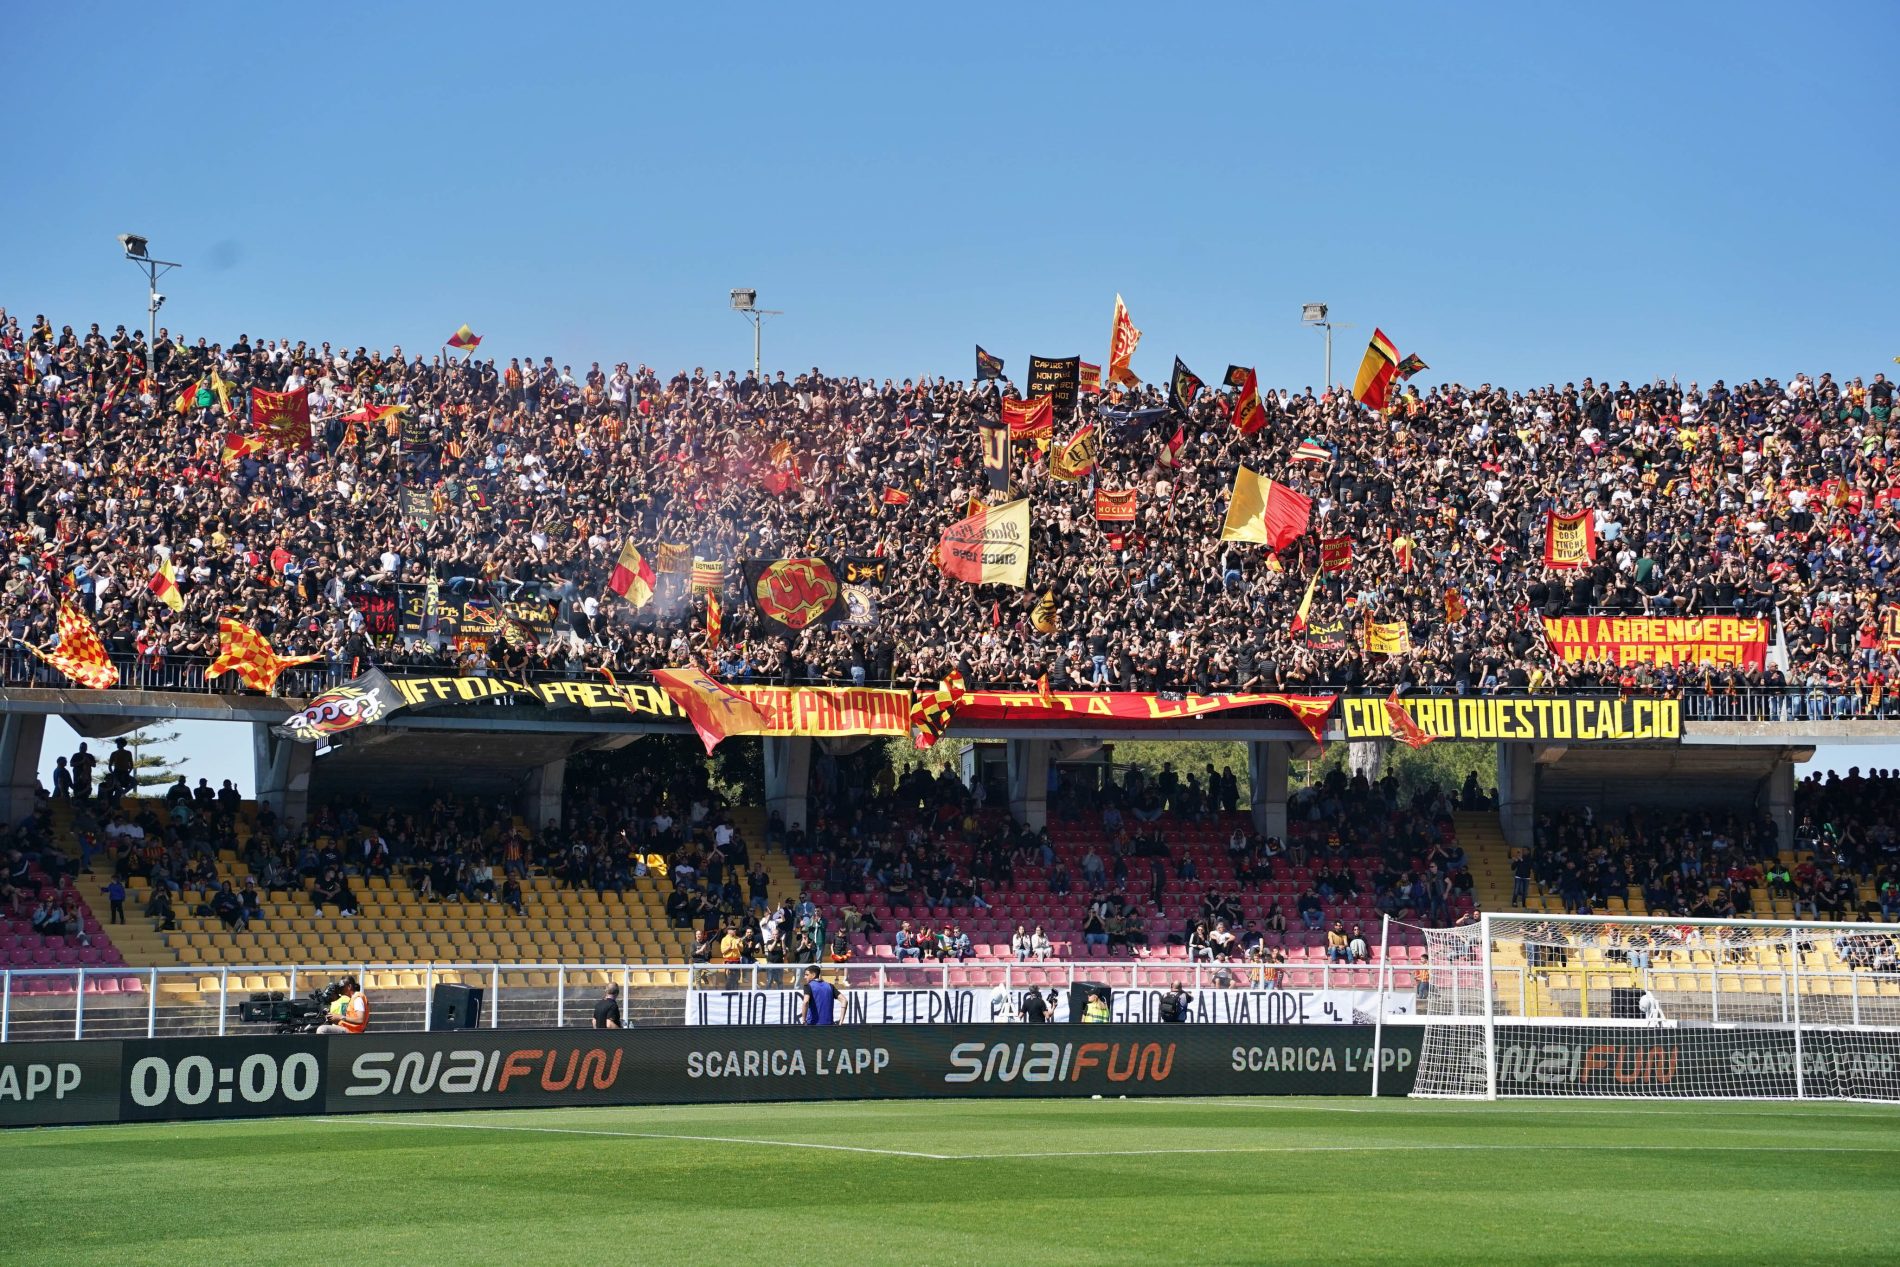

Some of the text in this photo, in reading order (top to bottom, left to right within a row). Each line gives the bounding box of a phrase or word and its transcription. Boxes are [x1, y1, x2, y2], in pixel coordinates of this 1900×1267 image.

[1034, 360, 1063, 369] CAPIRE
[1309, 620, 1344, 635] SENZA
[1545, 618, 1765, 643] MAI ARRENDERSI
[1564, 645, 1743, 667] MAI PENTIRSI
[800, 690, 909, 731] PADRONI
[1459, 699, 1572, 739] QUESTO
[1577, 700, 1680, 739] CALCIO
[698, 992, 708, 1025] IL
[721, 991, 766, 1025] TUO
[883, 990, 974, 1024] ETERNO
[687, 1048, 890, 1079] SCARICA L'APP
[1232, 1046, 1412, 1073] SCARICA L'APP
[0, 1063, 81, 1101] APP
[130, 1052, 319, 1107] 00:00
